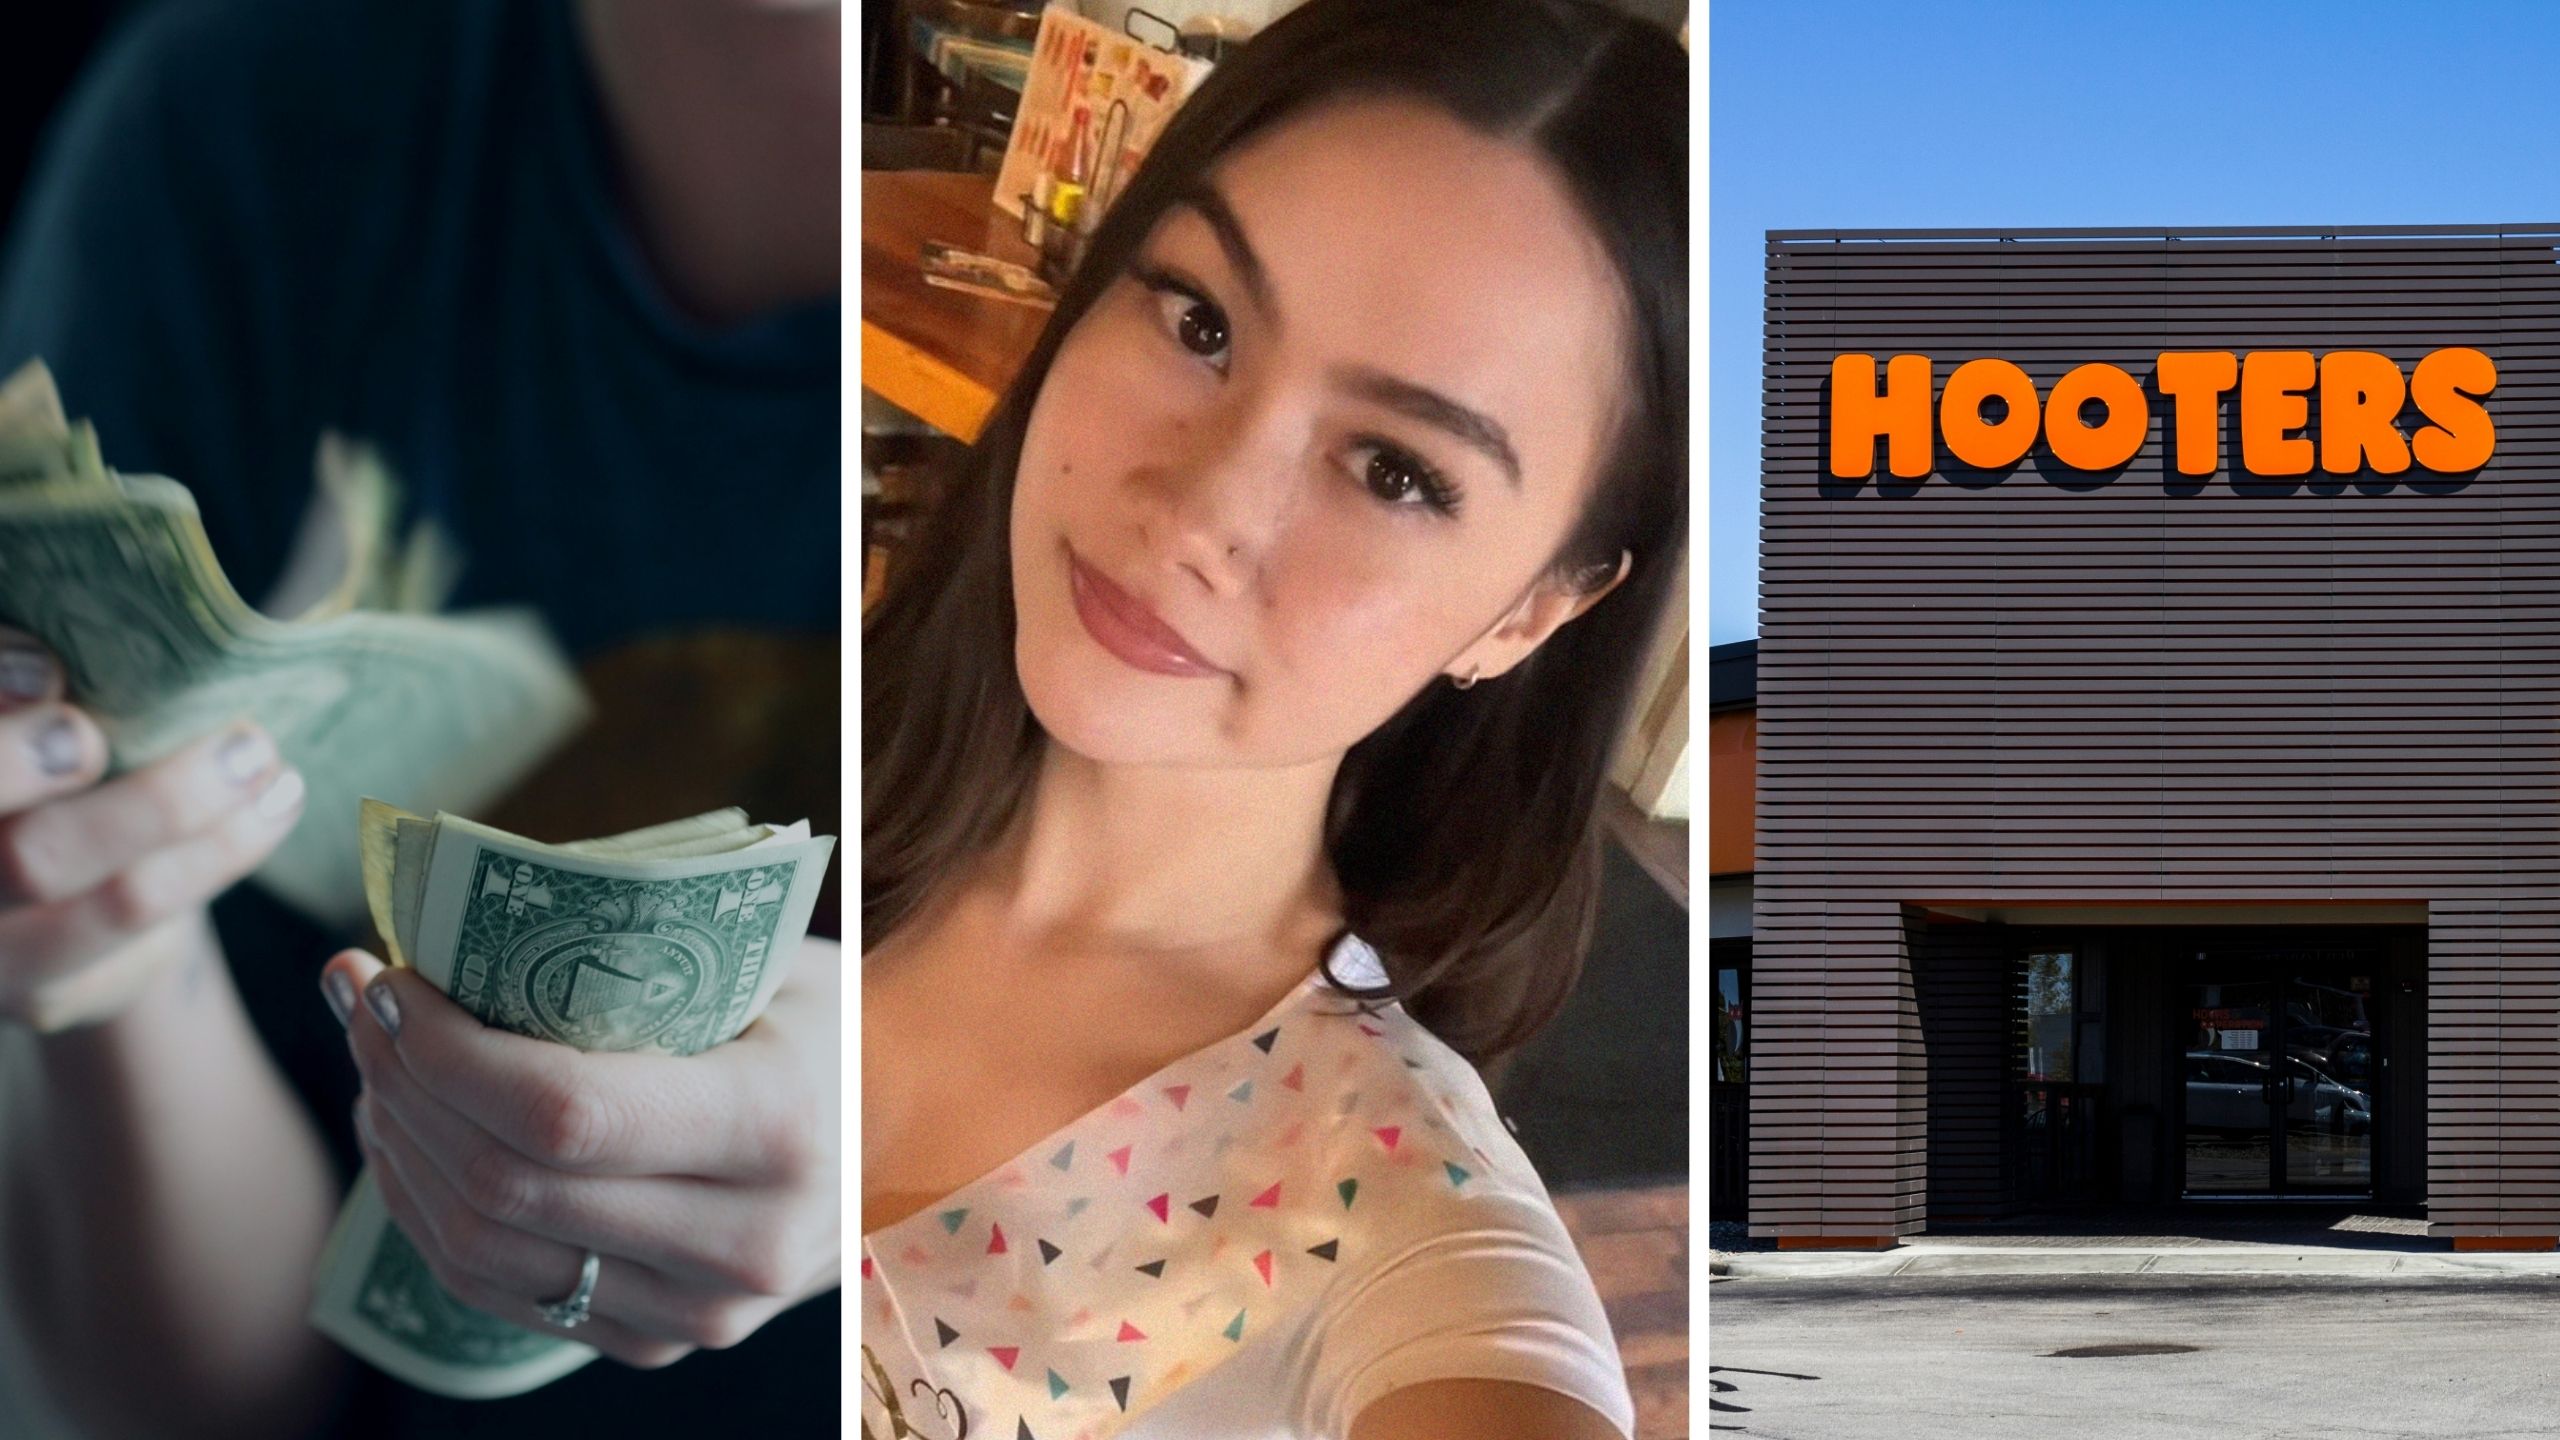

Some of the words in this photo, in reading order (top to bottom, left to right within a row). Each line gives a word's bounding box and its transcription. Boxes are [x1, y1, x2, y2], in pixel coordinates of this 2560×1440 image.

[1830, 347, 2497, 478] HOOTERS
[506, 864, 534, 917] ONE
[737, 869, 765, 923] ONE
[458, 954, 488, 1014] ON
